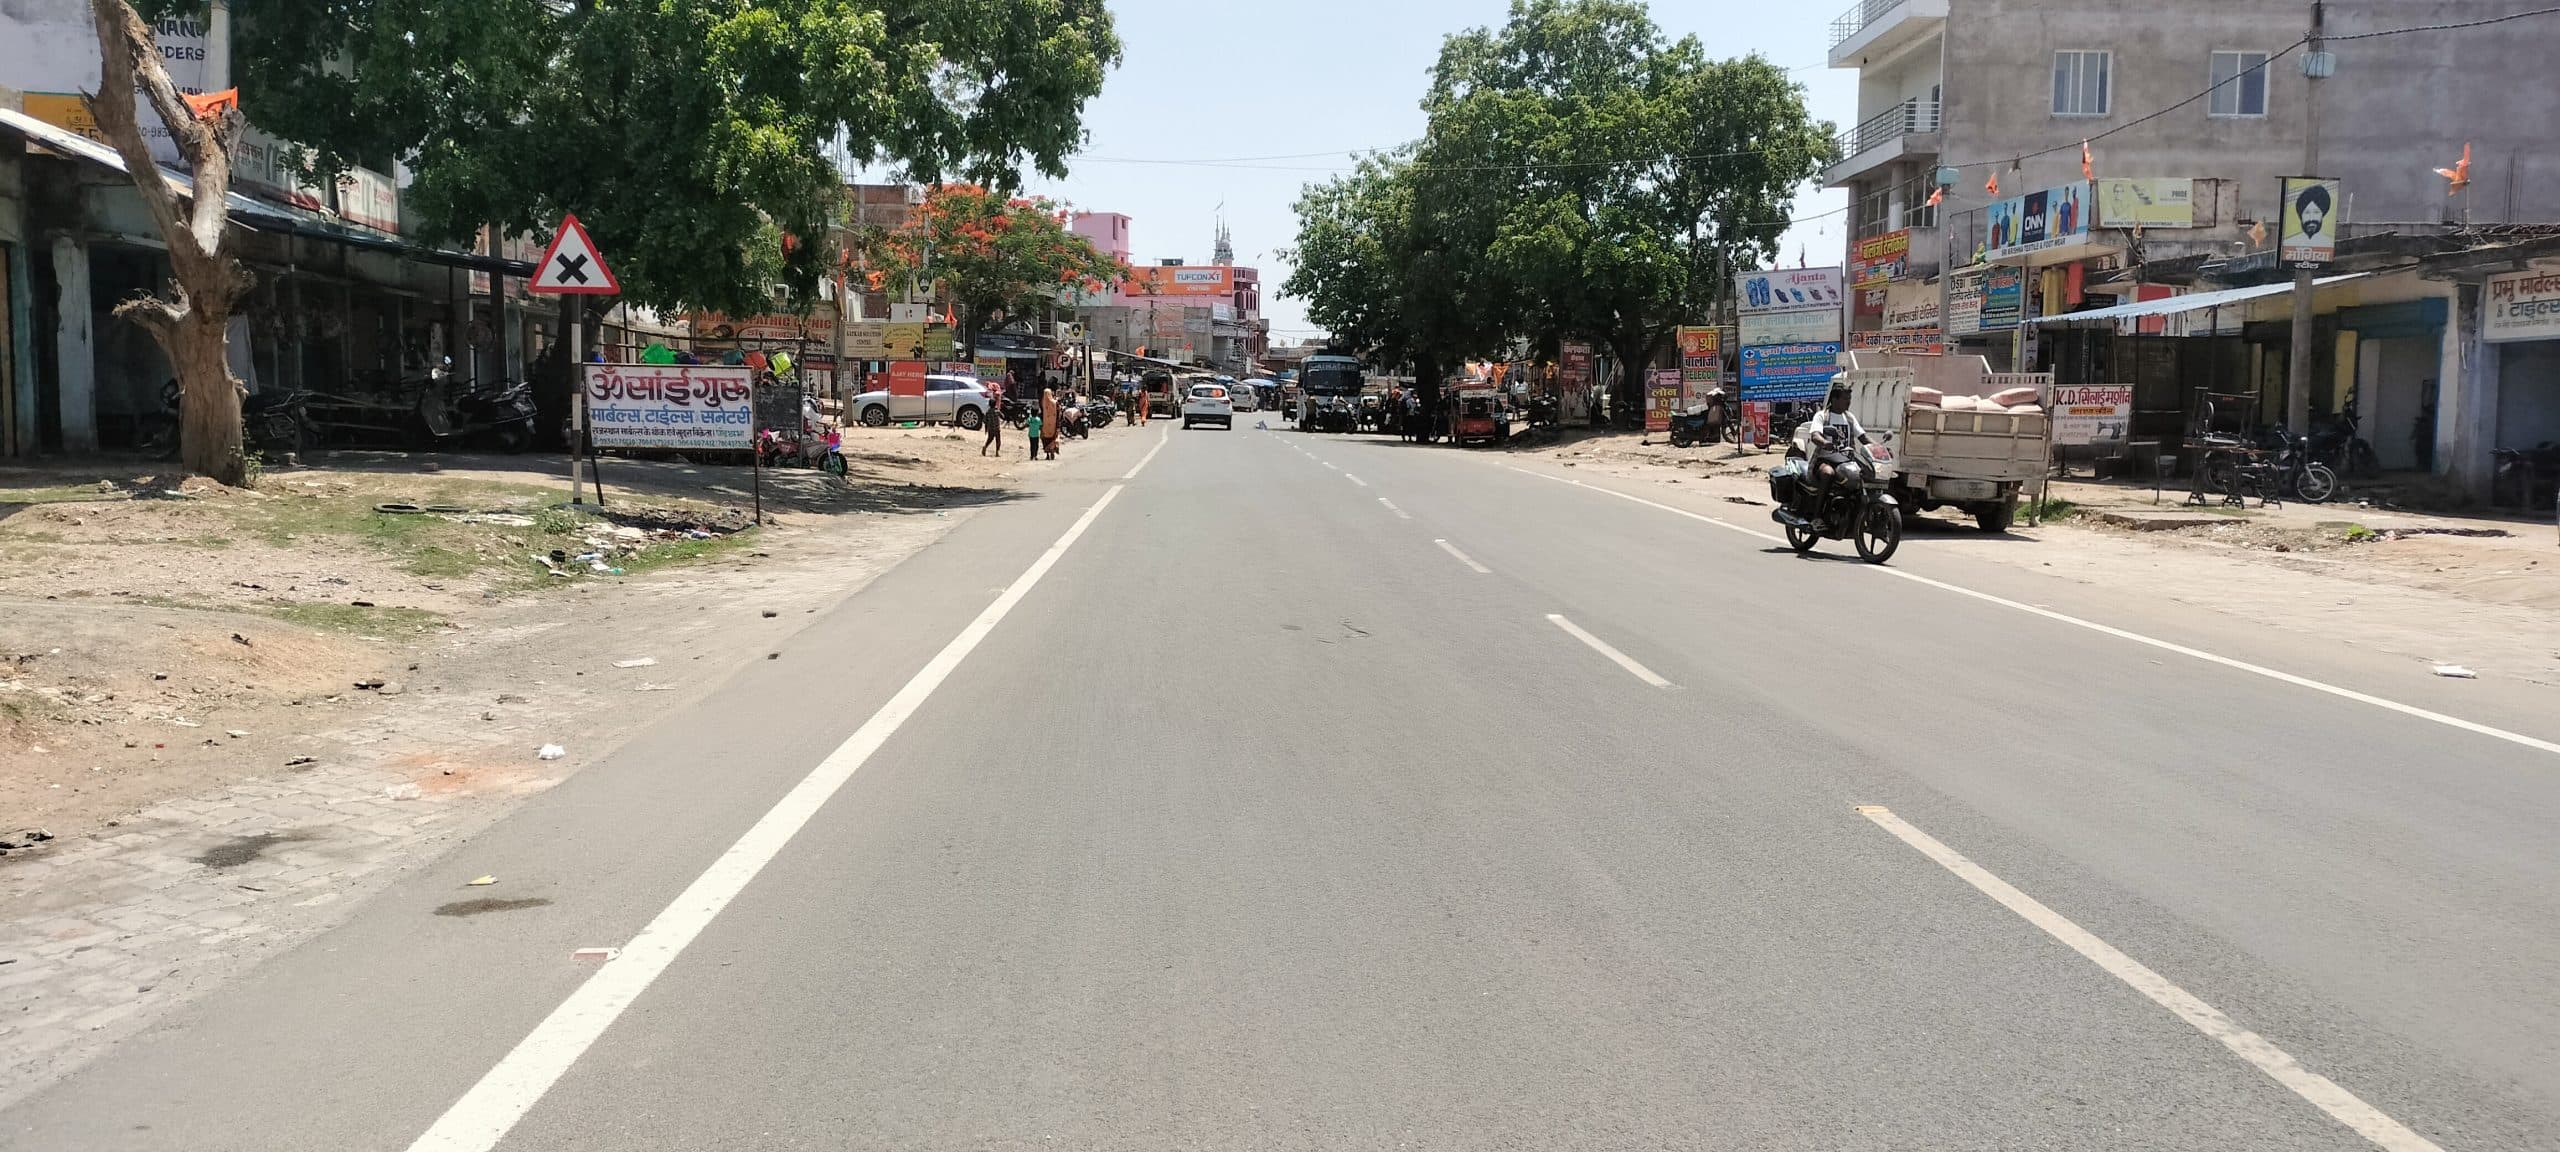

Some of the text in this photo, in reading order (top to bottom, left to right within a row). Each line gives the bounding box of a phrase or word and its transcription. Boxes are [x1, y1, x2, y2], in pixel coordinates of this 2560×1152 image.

[2024, 213, 2044, 231] ONN
[1785, 272, 1826, 285] Ajanta
[1699, 333, 1718, 351] श्री
